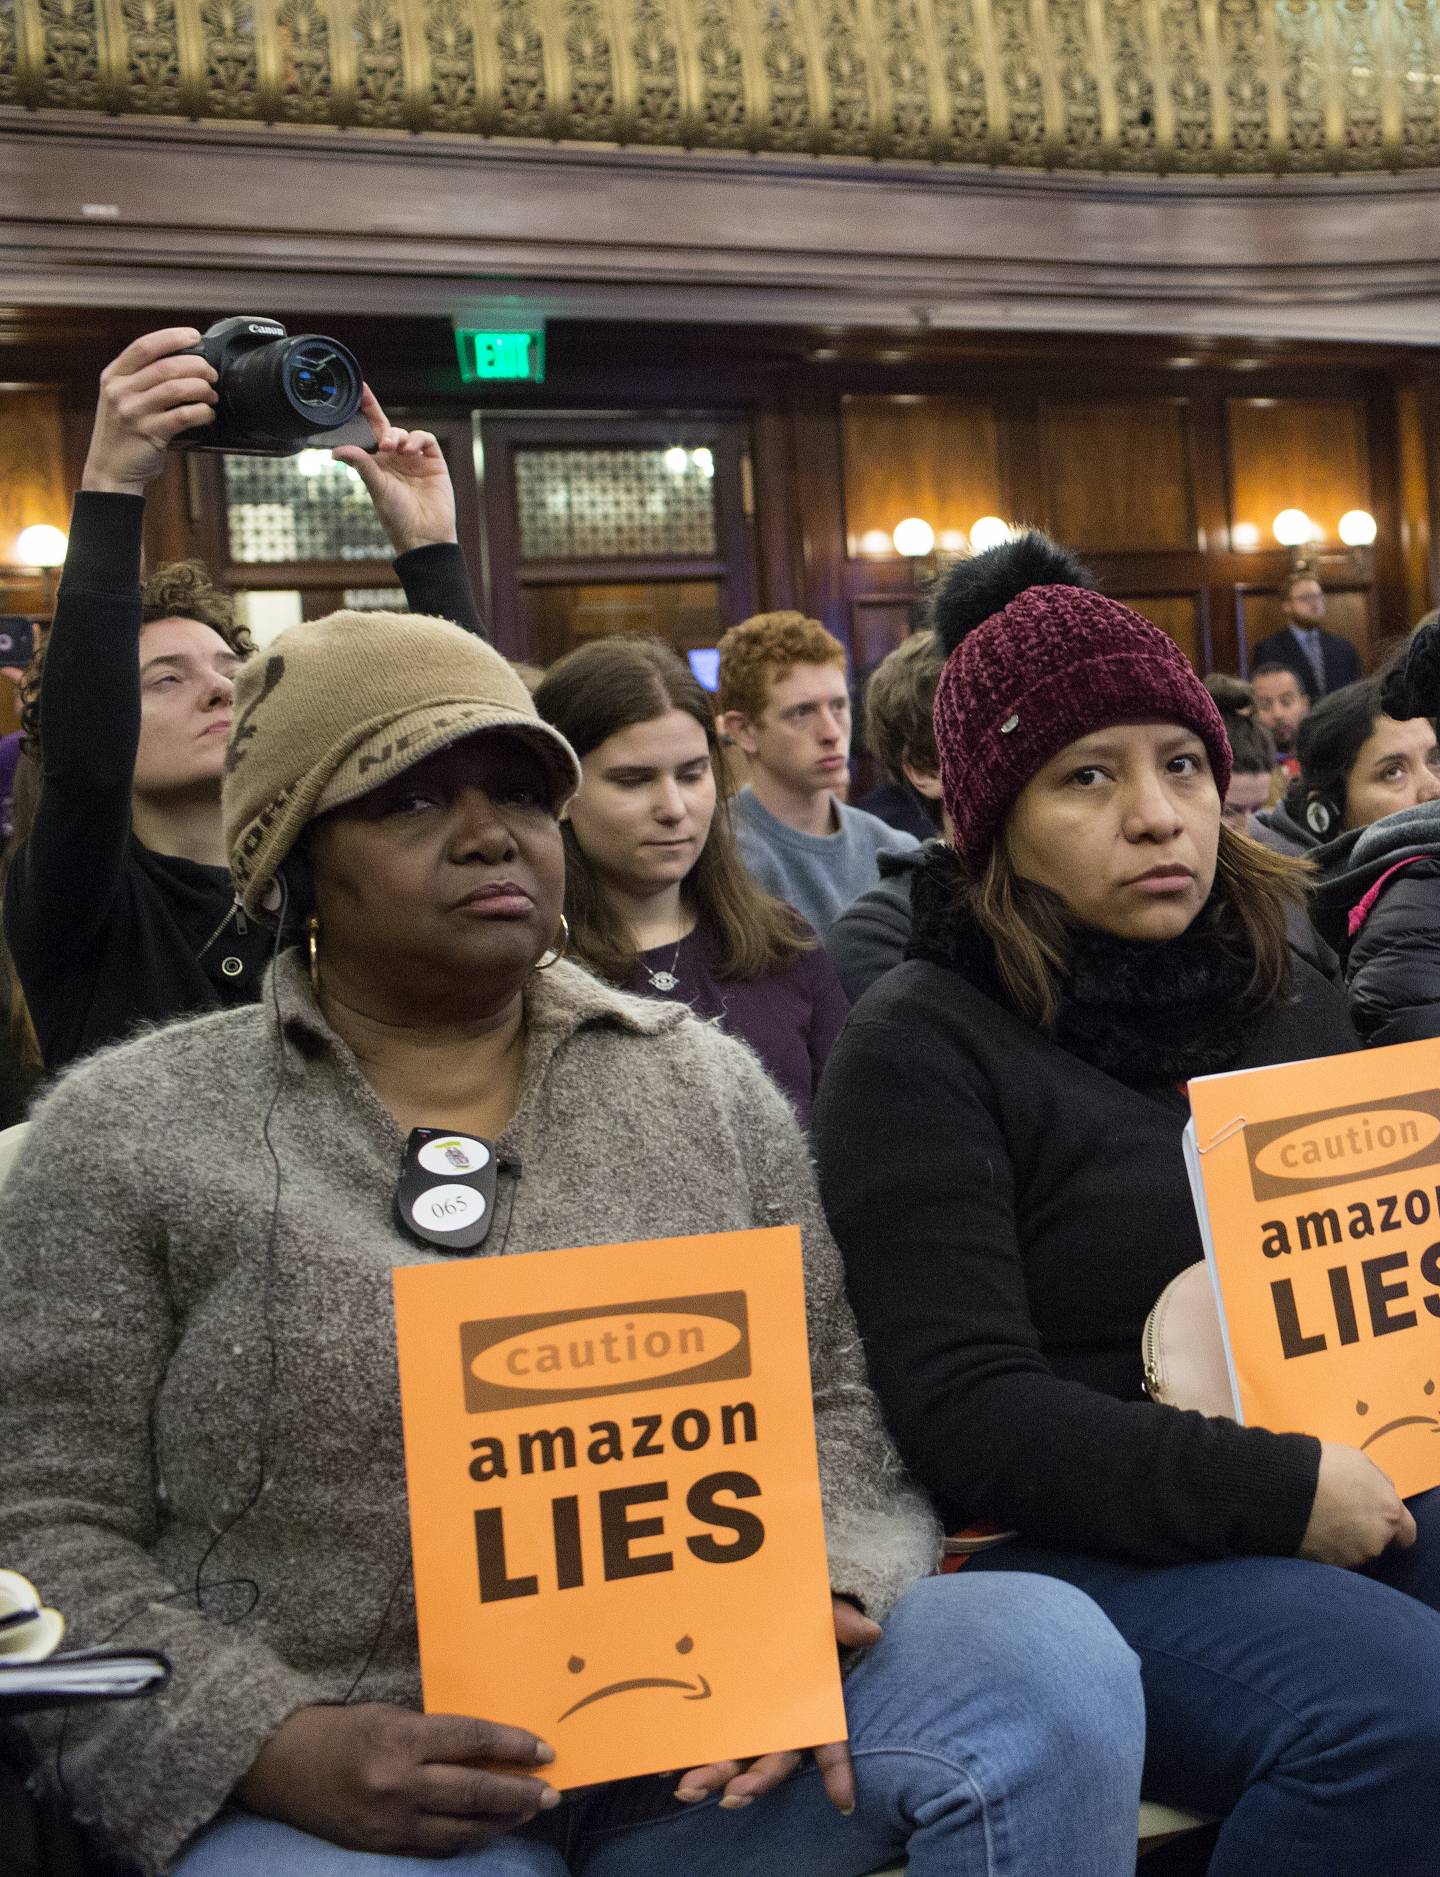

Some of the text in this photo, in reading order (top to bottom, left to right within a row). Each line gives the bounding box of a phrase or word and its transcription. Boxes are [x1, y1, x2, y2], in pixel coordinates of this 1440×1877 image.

[249, 323, 284, 336] Canon
[1279, 1118, 1420, 1169] caution
[431, 1195, 468, 1218] 065
[505, 1321, 706, 1376] caution
[468, 1400, 758, 1482] amazon
[473, 1470, 766, 1604] LIES
